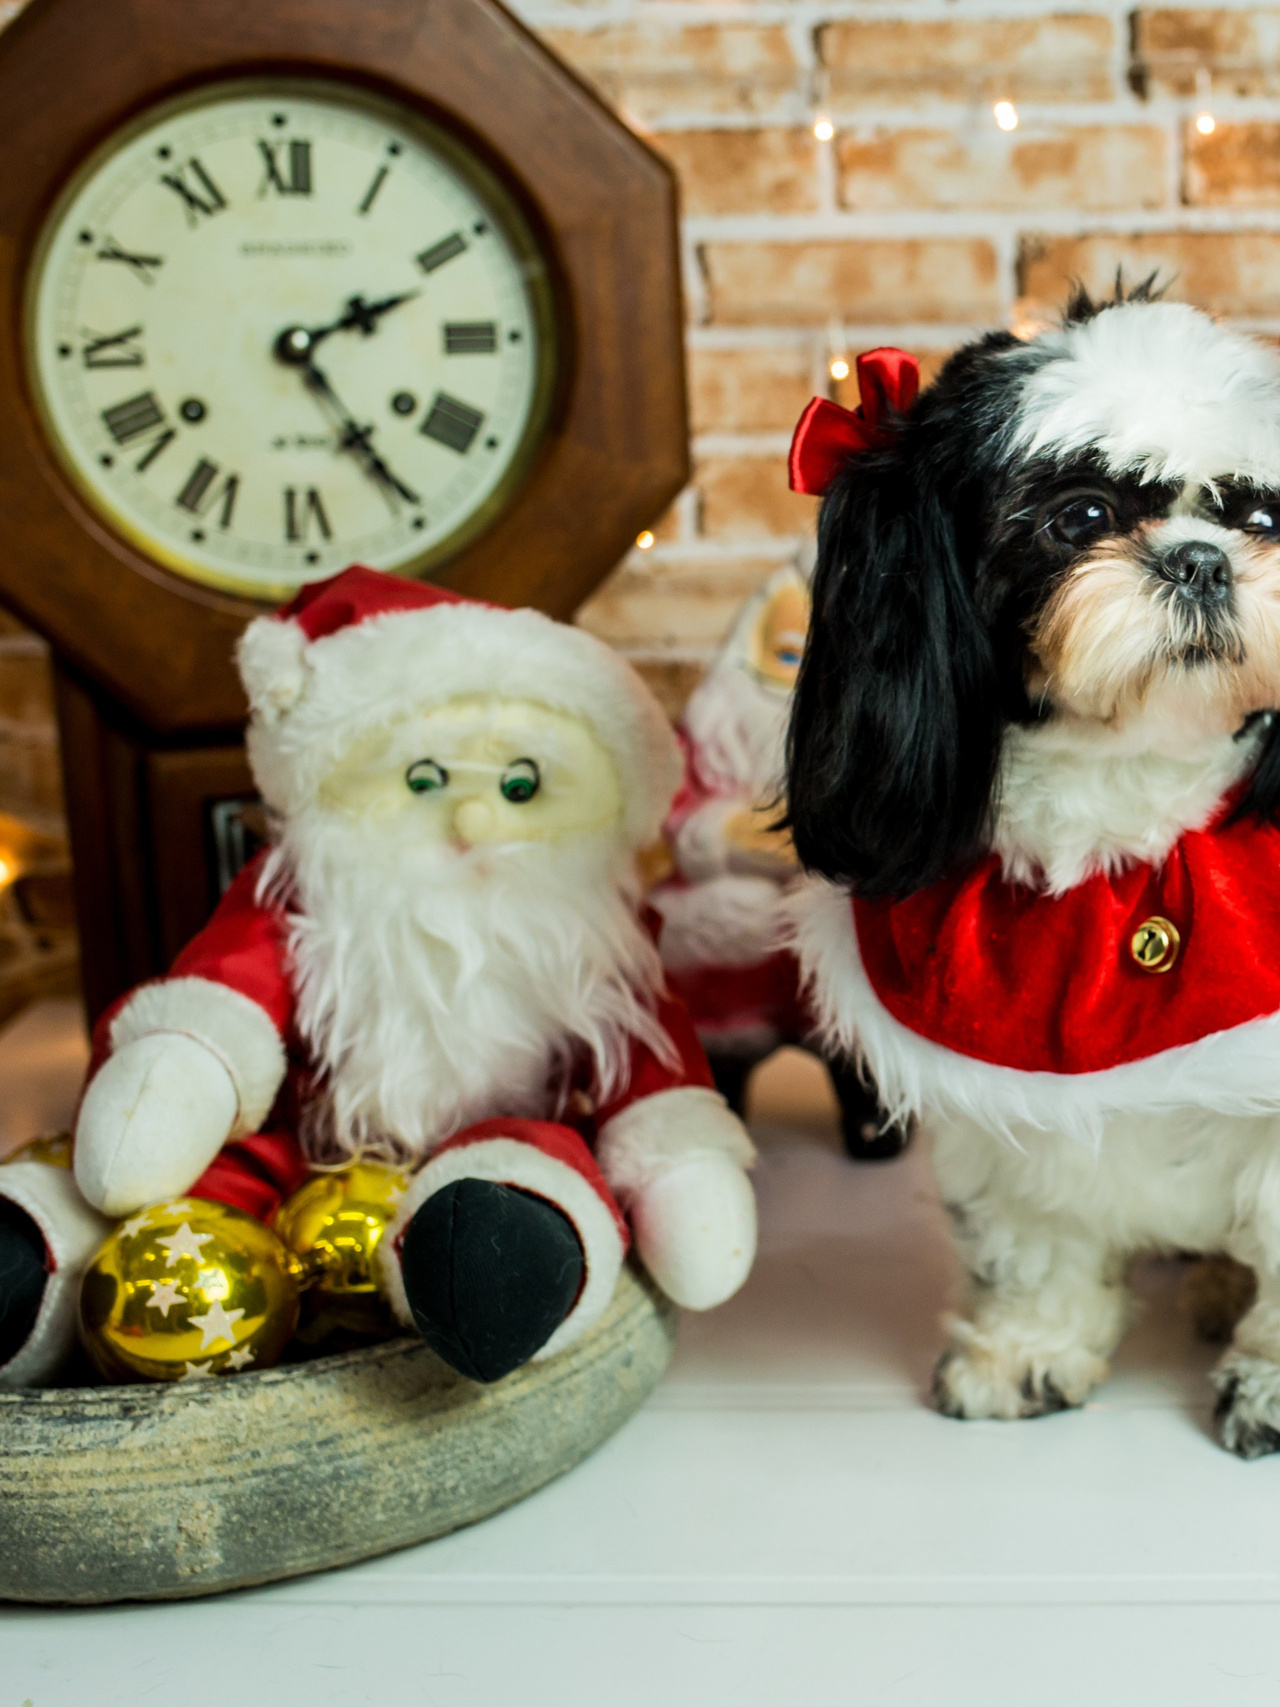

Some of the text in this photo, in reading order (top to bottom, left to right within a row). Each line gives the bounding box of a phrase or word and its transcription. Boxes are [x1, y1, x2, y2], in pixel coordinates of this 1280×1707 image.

[160, 156, 228, 229] XI
[82, 326, 143, 368] IX
[285, 485, 331, 542] VI
